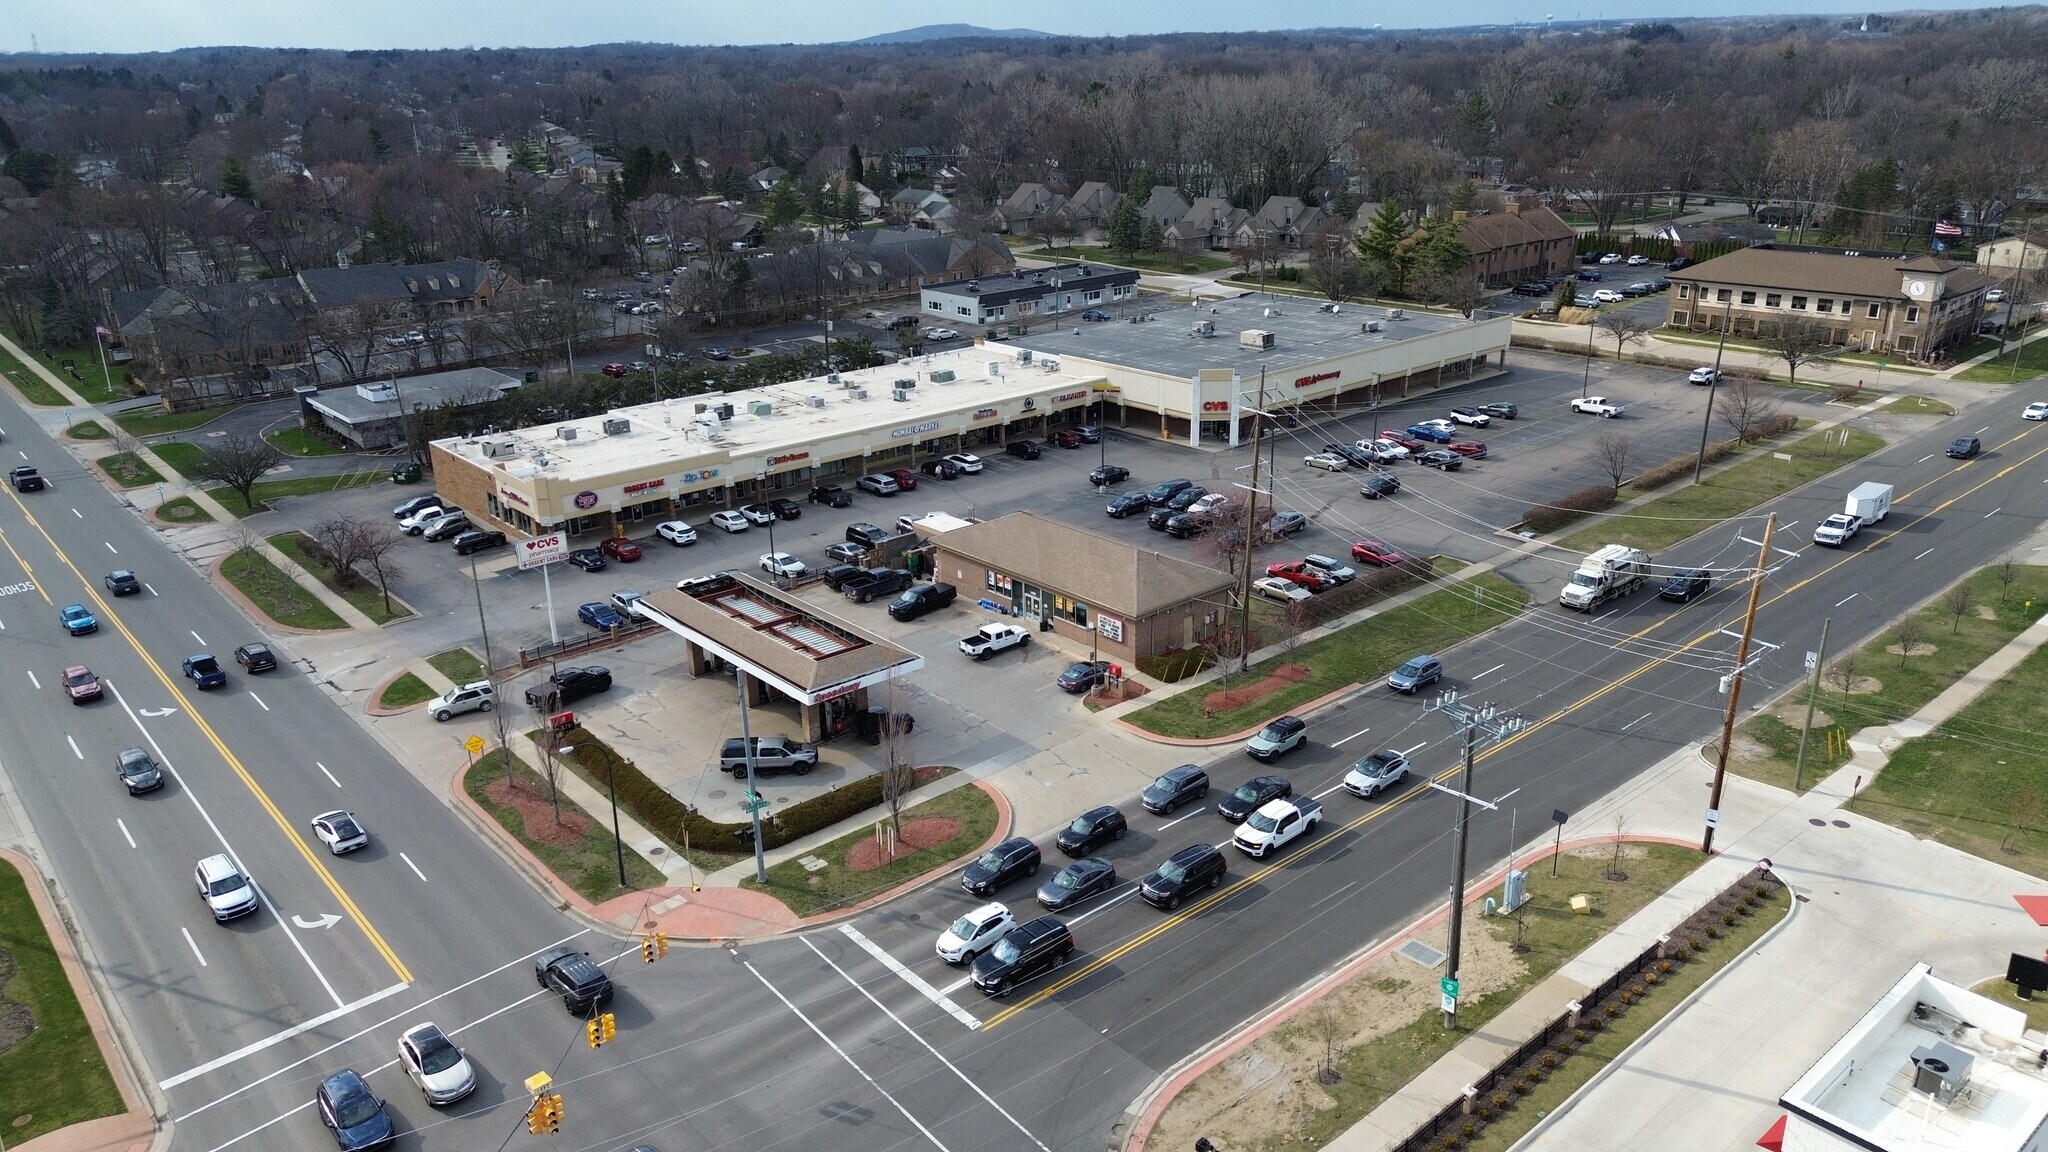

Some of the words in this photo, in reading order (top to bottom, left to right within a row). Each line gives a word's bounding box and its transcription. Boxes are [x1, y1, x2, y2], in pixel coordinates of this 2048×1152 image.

[1203, 401, 1228, 411] CVS
[919, 422, 941, 432] MARKET
[624, 482, 648, 493] URGENT
[649, 479, 665, 489] CARE
[537, 536, 559, 549] CVS
[529, 546, 559, 559] pharmacy
[528, 558, 546, 567] URGENT
[815, 681, 861, 702] Speedway
